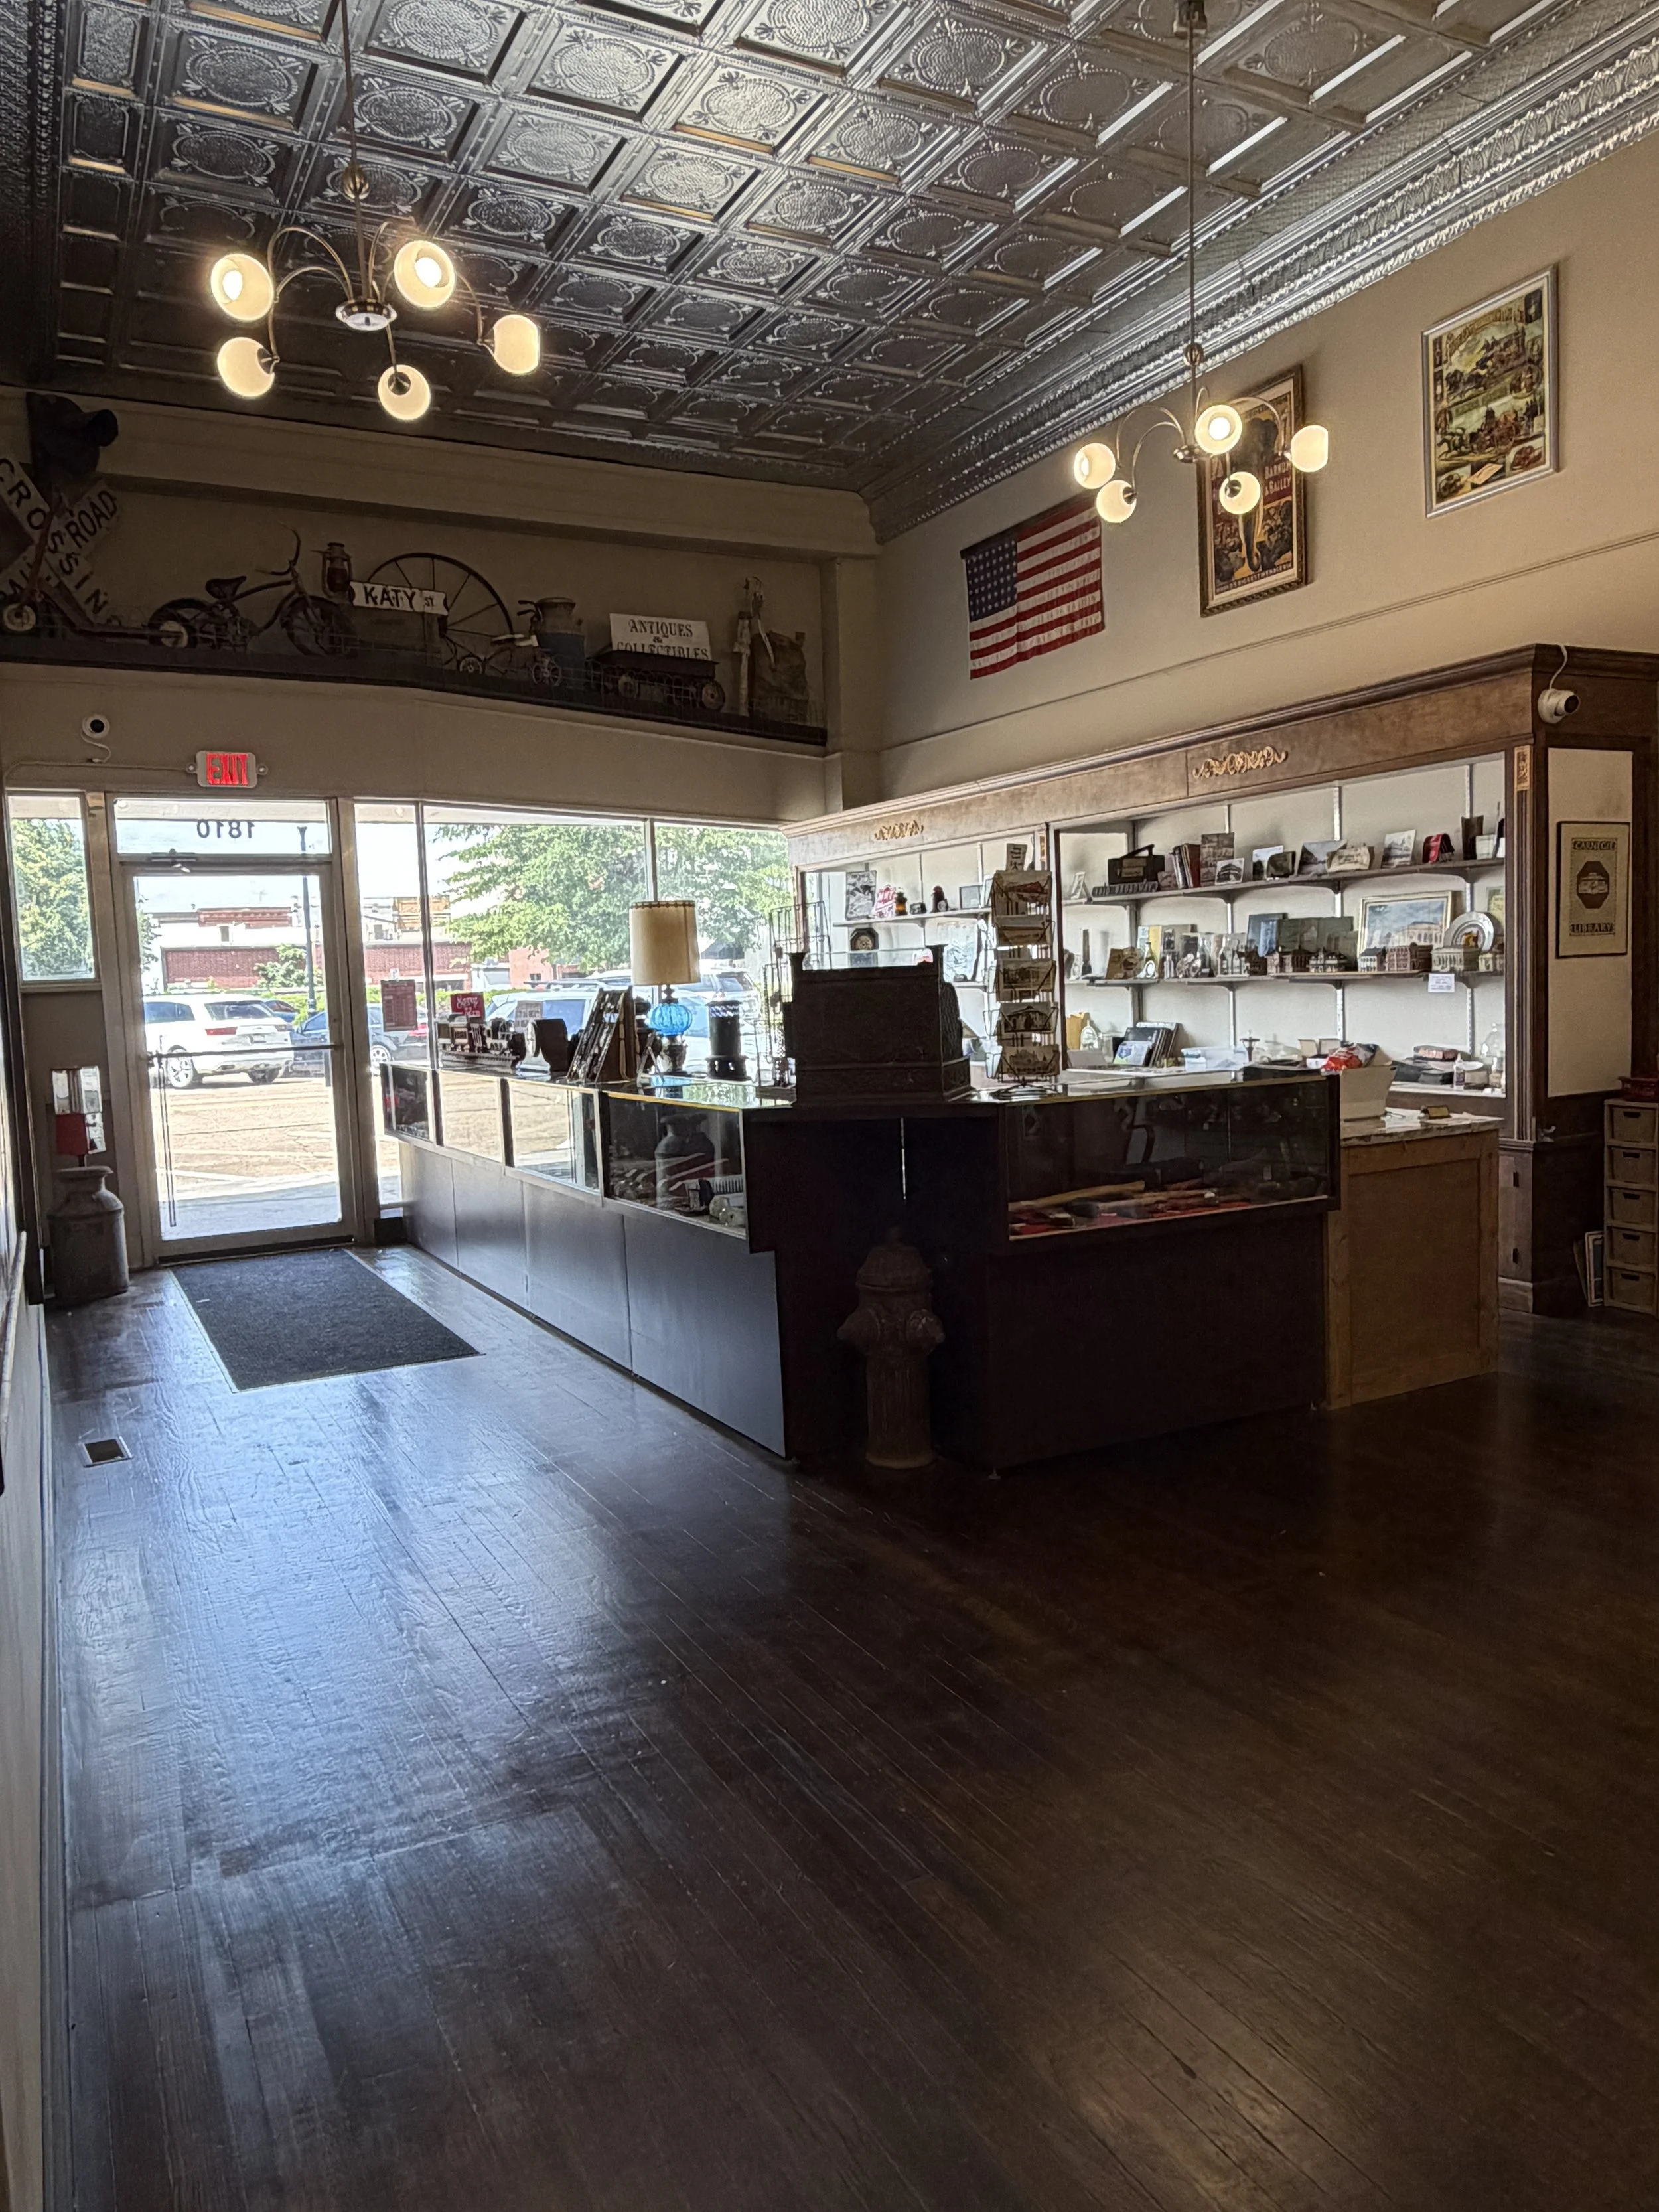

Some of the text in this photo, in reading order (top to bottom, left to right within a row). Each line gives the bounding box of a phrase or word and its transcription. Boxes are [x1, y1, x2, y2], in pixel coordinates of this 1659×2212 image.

[1269, 475, 1291, 494] BAILEY
[65, 490, 117, 549] ROAD
[363, 586, 435, 609] KATY ST
[628, 619, 693, 638] ANTIQUES
[206, 752, 249, 786] EXIT
[1573, 923, 1613, 933] LIBRARY
